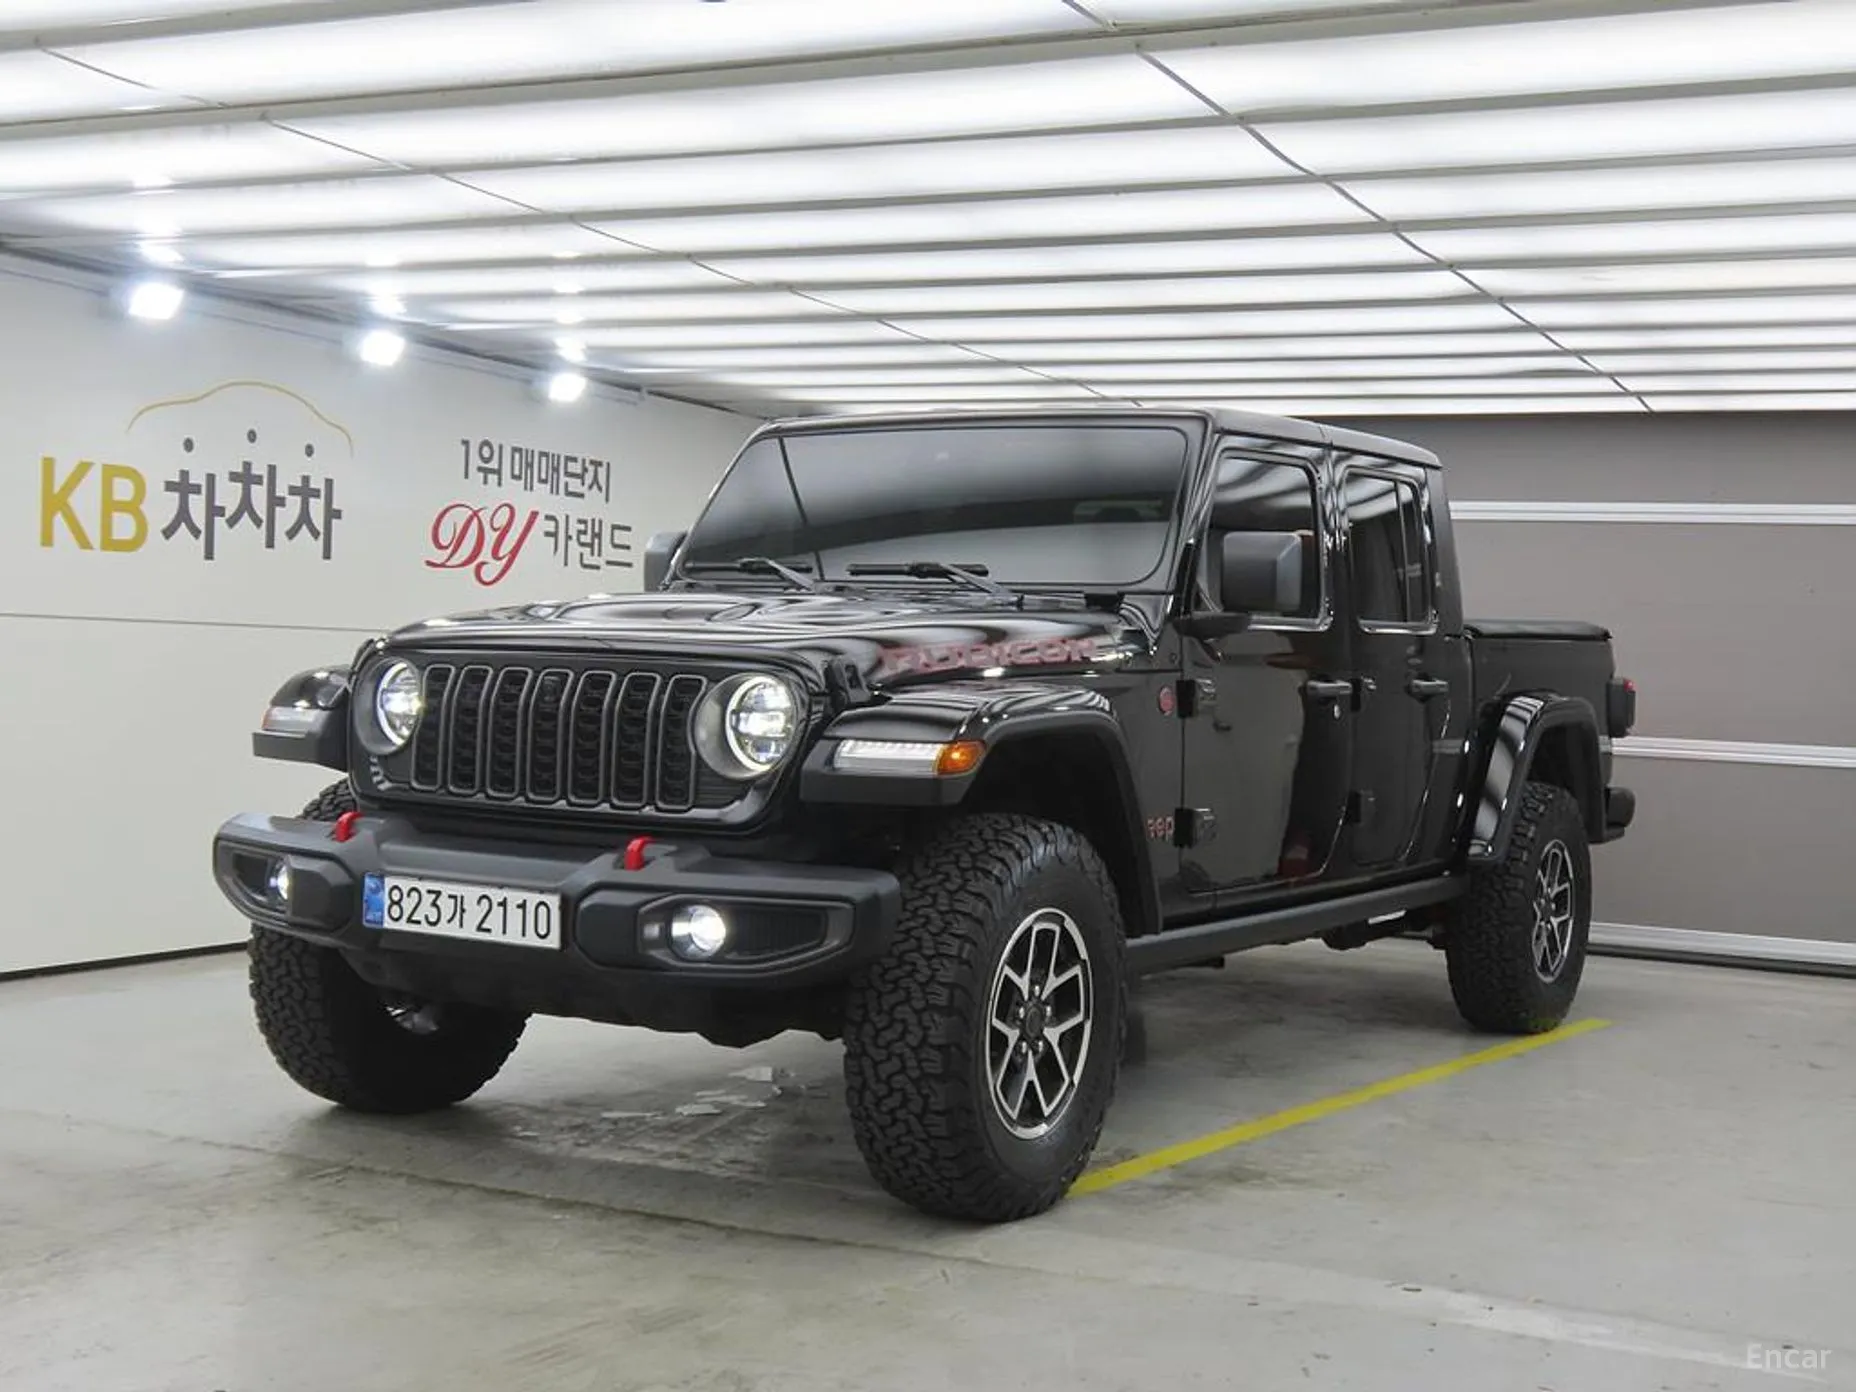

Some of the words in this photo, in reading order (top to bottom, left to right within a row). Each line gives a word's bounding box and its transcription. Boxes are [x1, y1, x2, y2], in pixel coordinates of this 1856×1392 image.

[40, 456, 148, 553] KB
[161, 428, 342, 560] 차차차
[460, 438, 504, 488] 1위
[510, 444, 612, 503] 매매단지
[425, 502, 540, 586] DY
[543, 515, 634, 569] 카랜드
[387, 884, 467, 929] 823가
[475, 894, 551, 940] 2110
